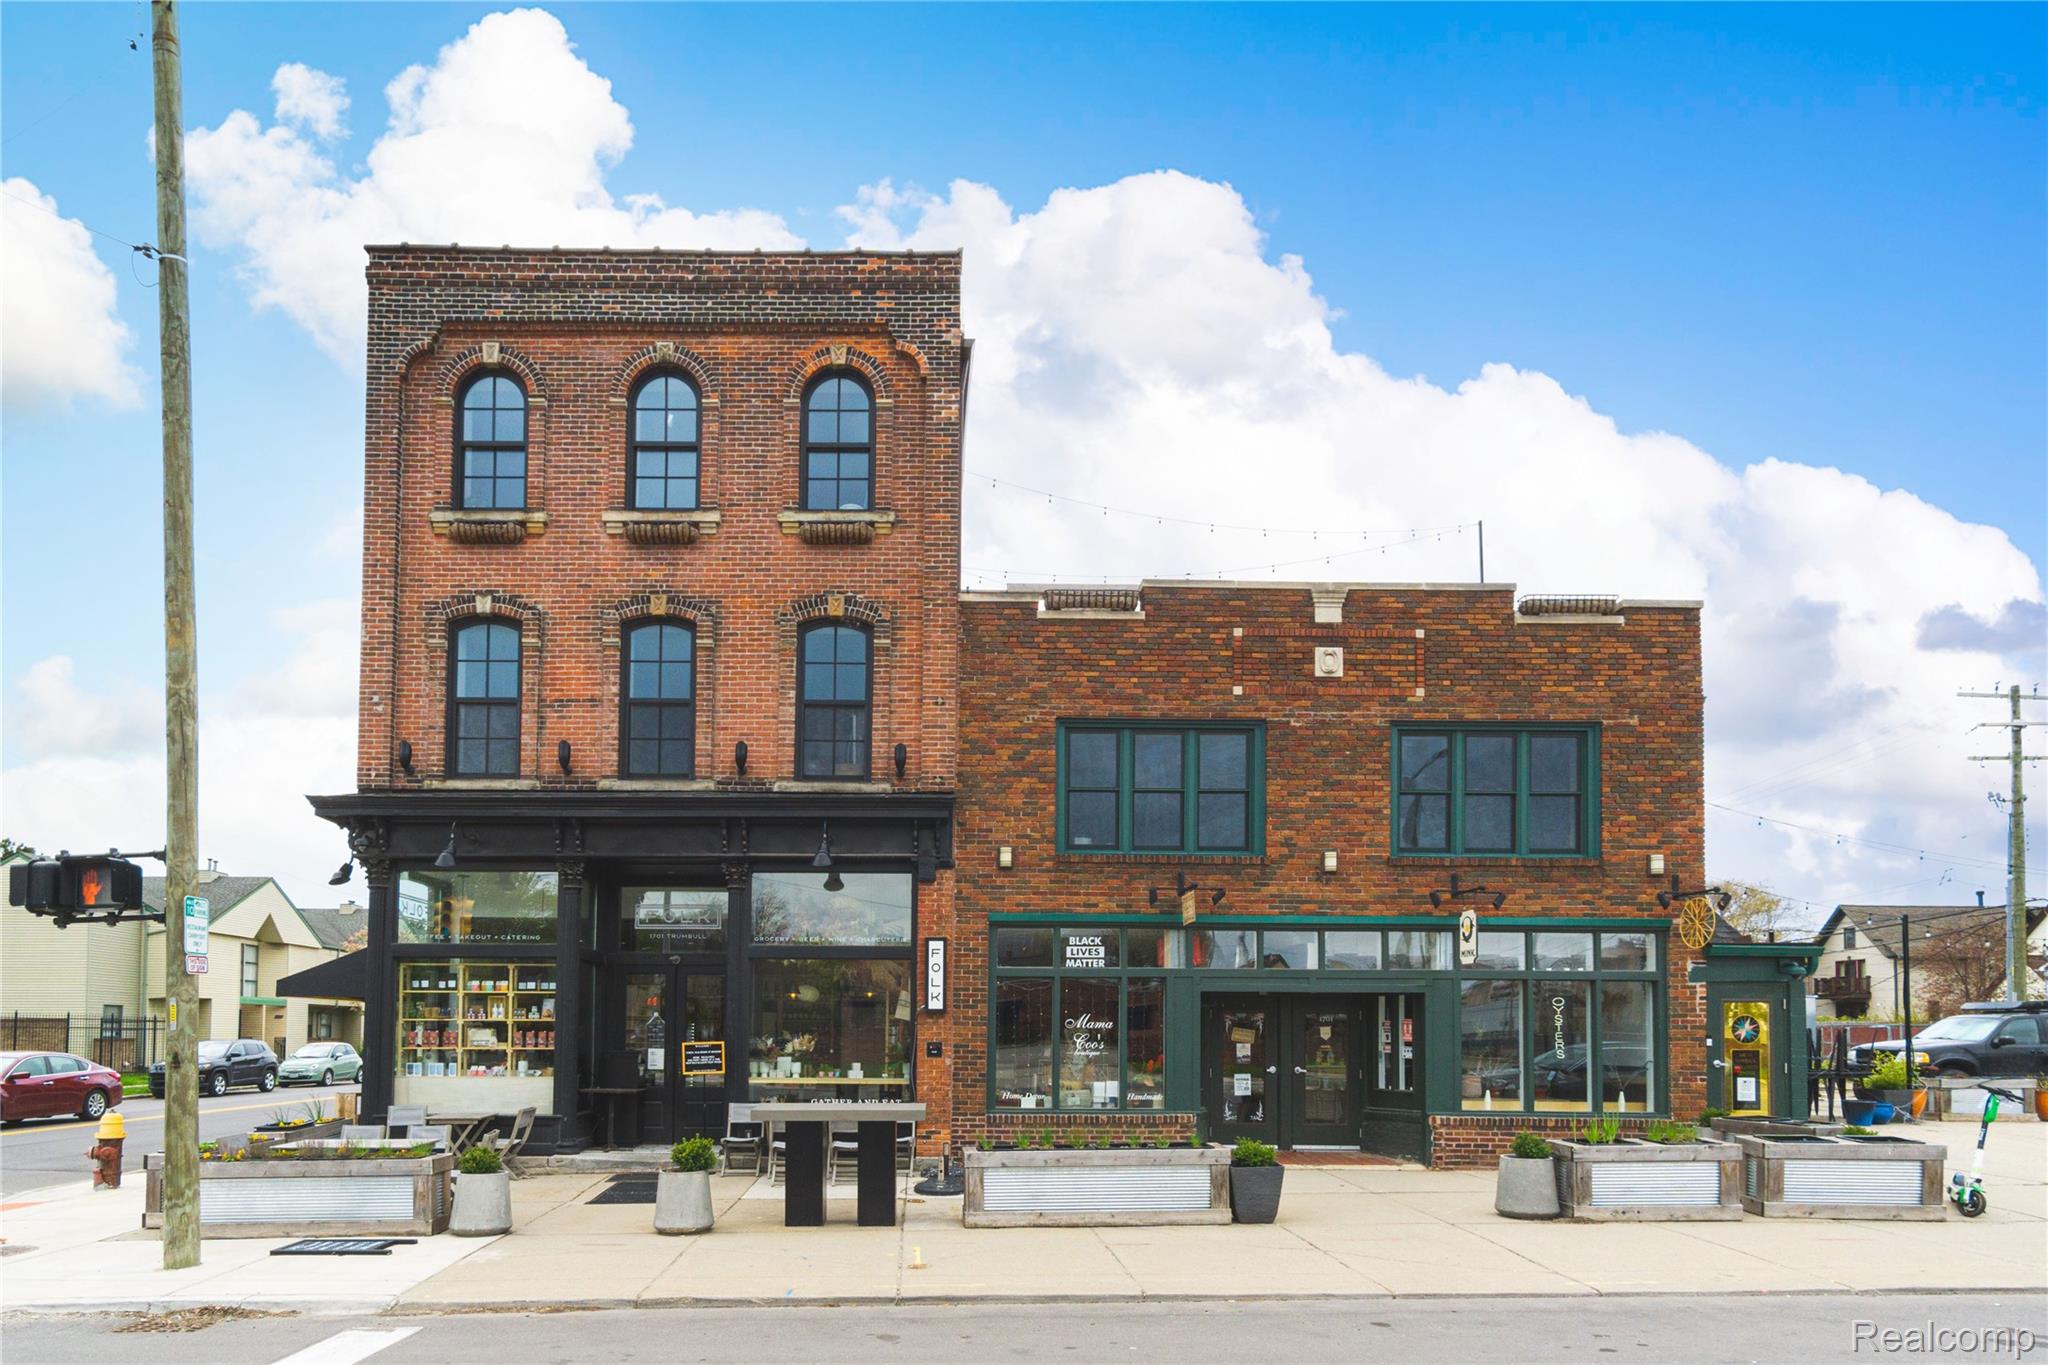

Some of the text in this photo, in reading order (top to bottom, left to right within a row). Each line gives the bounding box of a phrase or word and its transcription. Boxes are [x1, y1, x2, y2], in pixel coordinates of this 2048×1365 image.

[646, 910, 711, 923] FOLK
[1069, 936, 1102, 945] BLACK
[1070, 947, 1100, 956] LIVES
[1066, 958, 1105, 968] MATTER
[931, 948, 941, 1002] FOLK
[1065, 1013, 1114, 1029] Mama
[1552, 996, 1566, 1059] OYSTERS
[1073, 1033, 1104, 1050] Coo's
